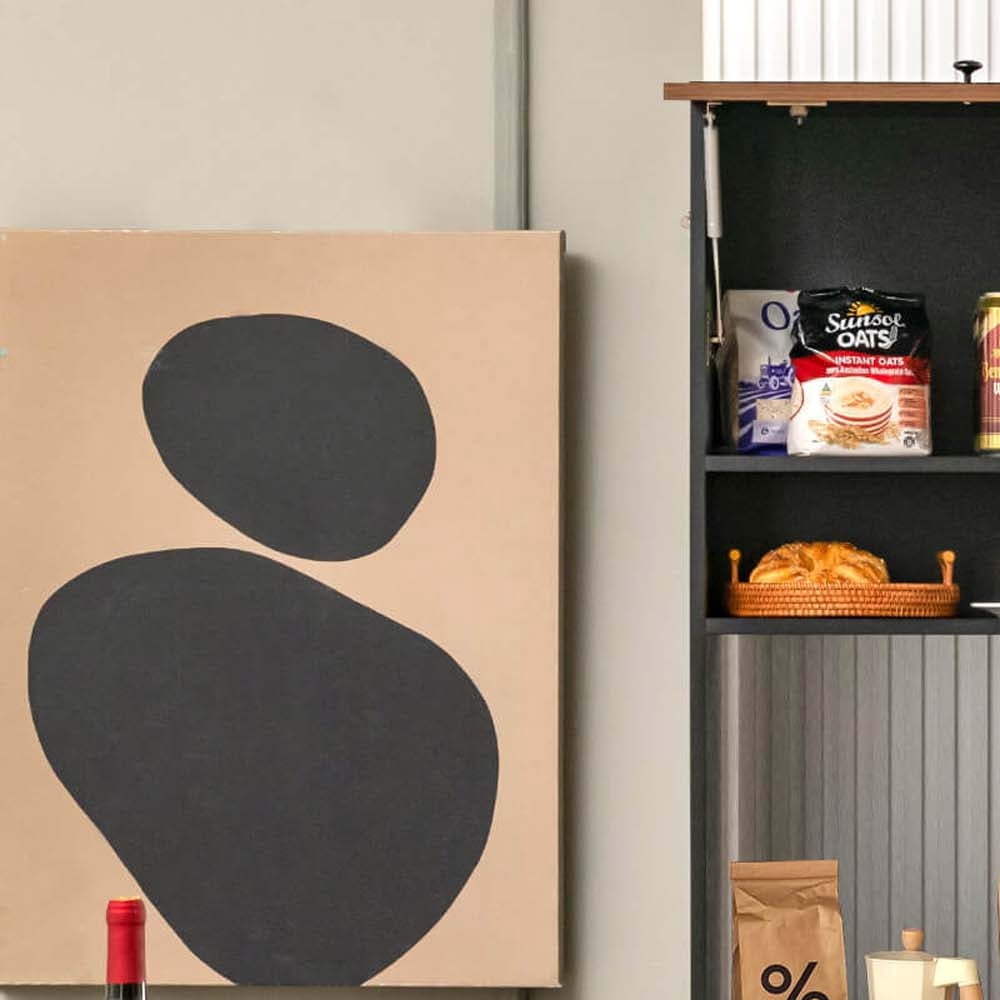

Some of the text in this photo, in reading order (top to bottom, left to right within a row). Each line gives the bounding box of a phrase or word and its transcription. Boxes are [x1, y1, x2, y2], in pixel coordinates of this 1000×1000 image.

[825, 313, 906, 333] Sunsol
[837, 329, 893, 349] OATS
[834, 355, 904, 366] INSTANT OATS
